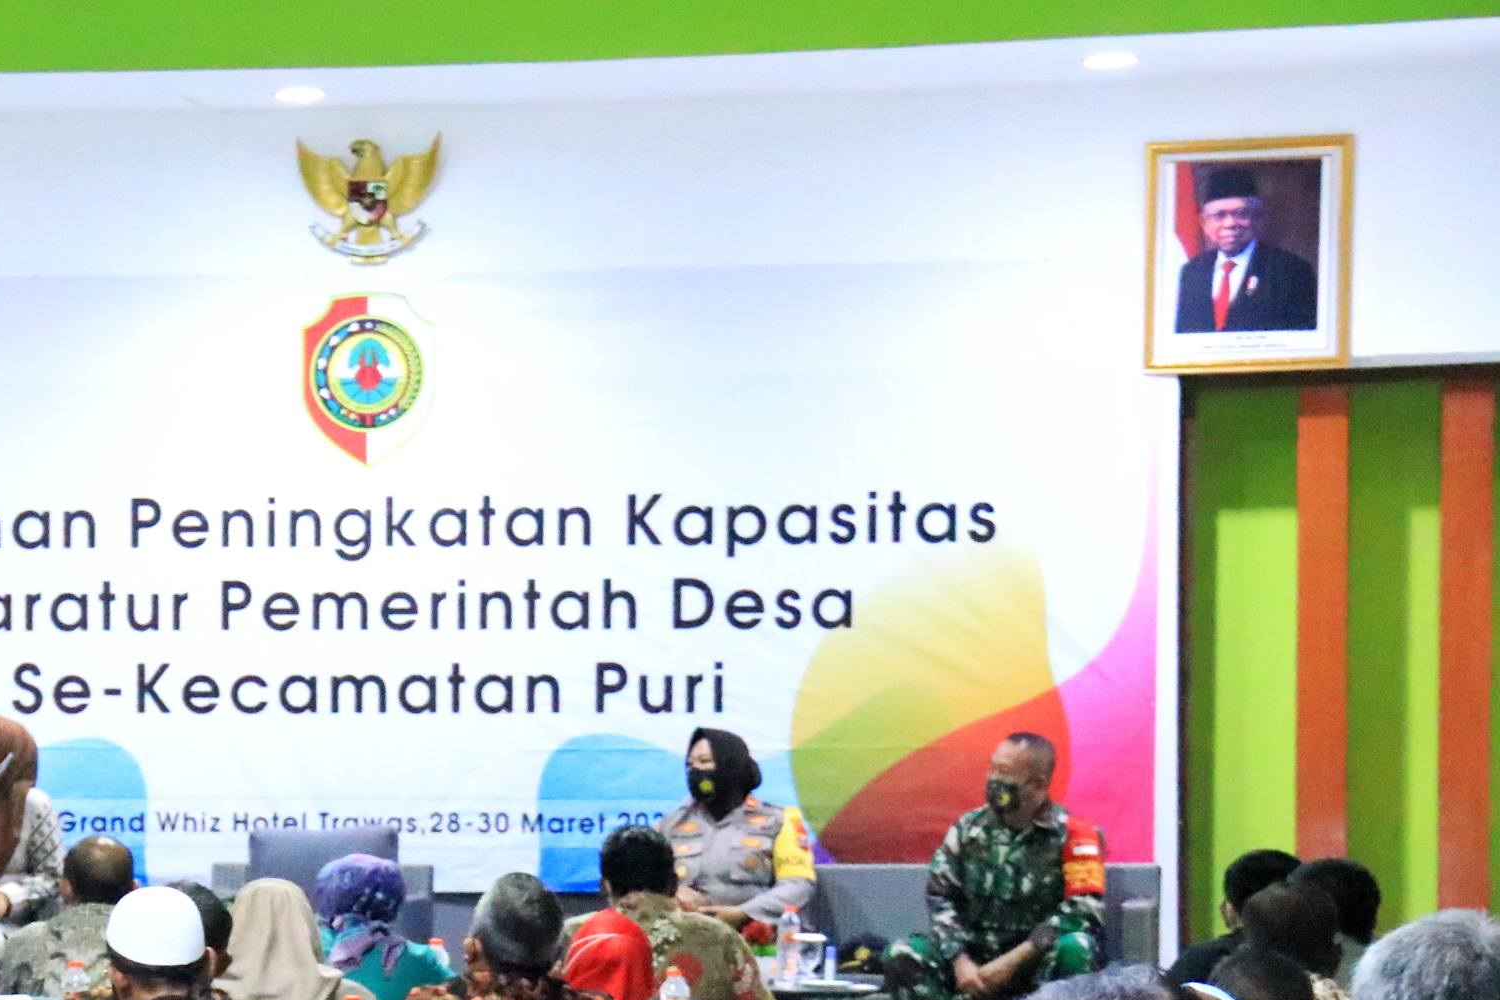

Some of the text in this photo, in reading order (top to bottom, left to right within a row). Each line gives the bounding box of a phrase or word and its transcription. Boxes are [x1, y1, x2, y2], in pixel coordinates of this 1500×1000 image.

[130, 494, 592, 562] Peningkatan
[626, 490, 997, 558] Kapasitas
[220, 577, 638, 632] Pemerintah
[672, 577, 853, 631] Desa
[11, 661, 724, 716] Se-Kecamatan Puri
[57, 811, 146, 834] Grand
[156, 811, 222, 833] Whiz
[232, 812, 307, 832] Hotel
[520, 812, 606, 835] Maret
